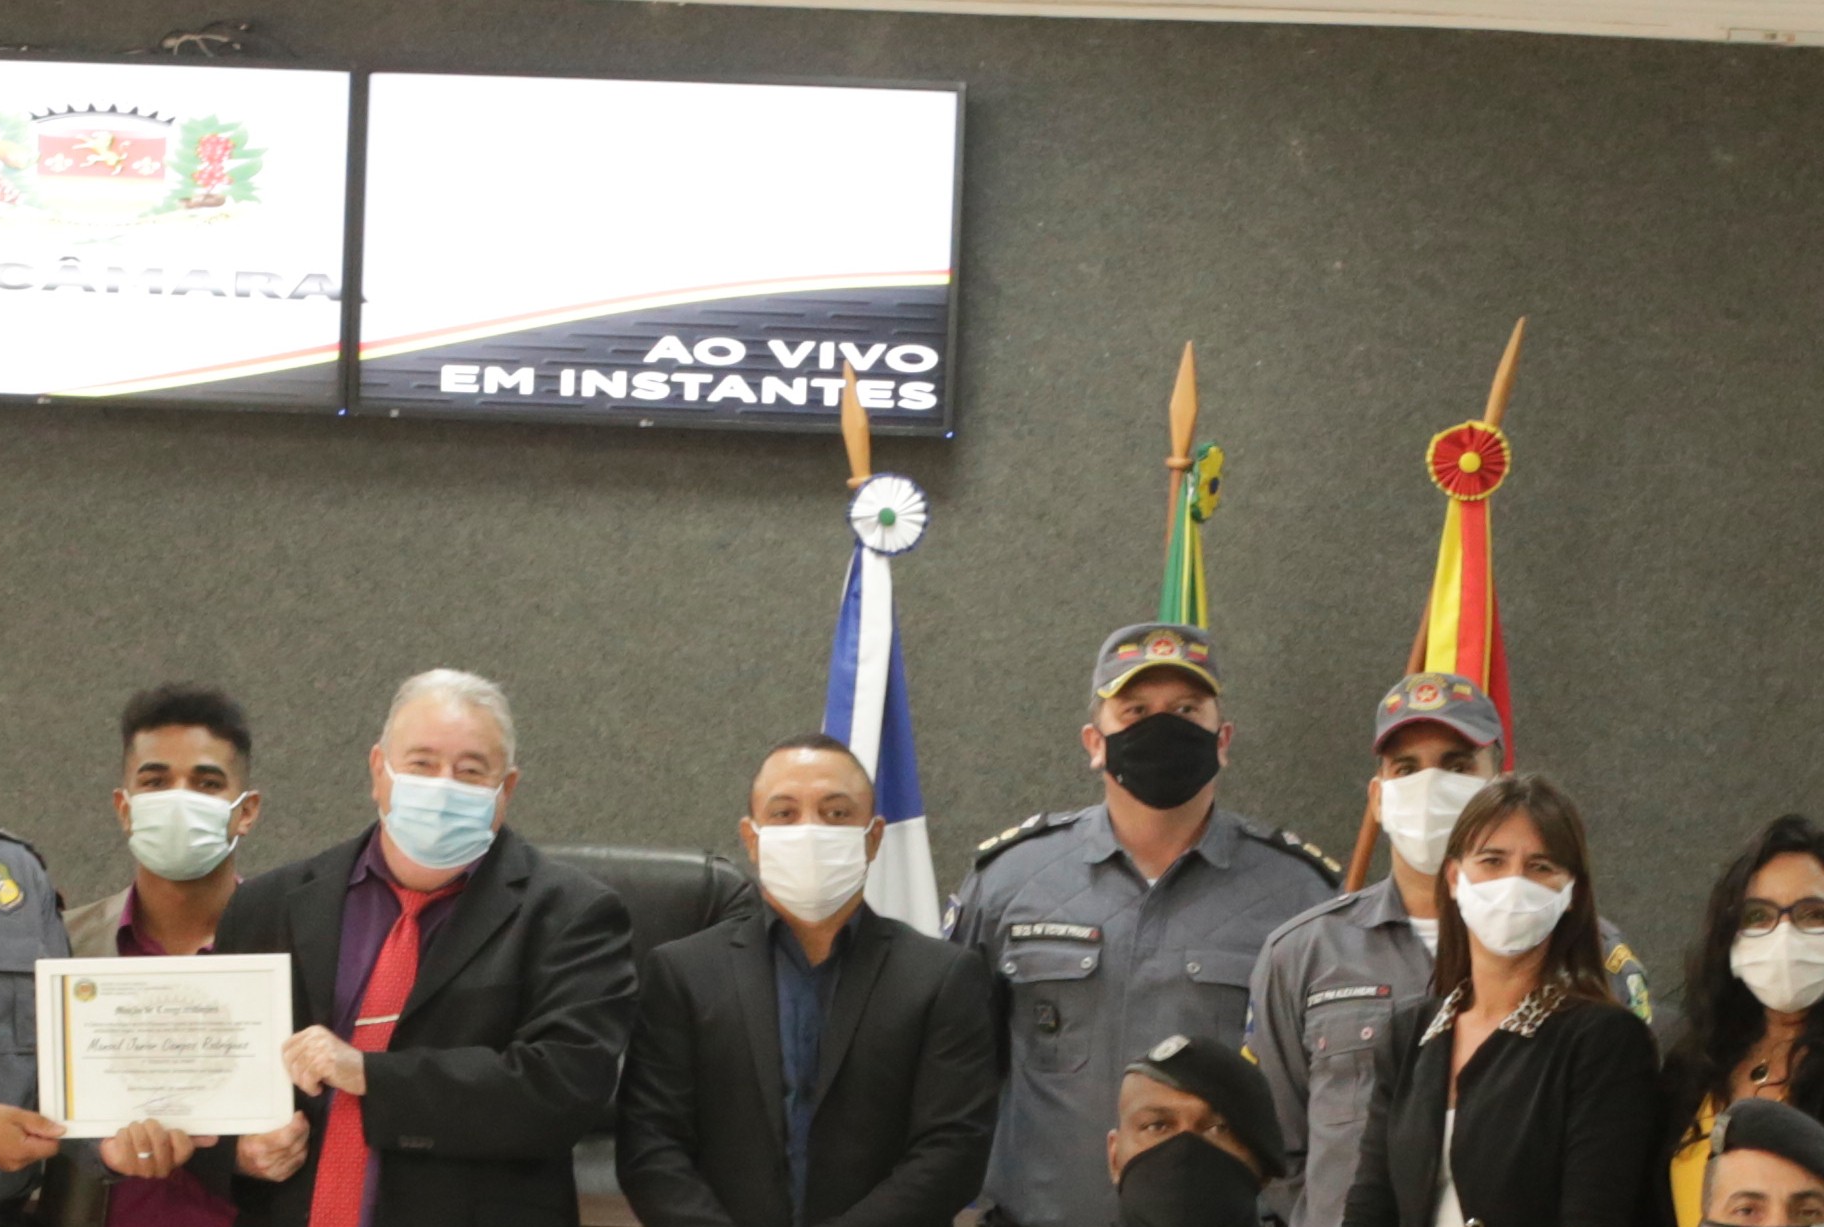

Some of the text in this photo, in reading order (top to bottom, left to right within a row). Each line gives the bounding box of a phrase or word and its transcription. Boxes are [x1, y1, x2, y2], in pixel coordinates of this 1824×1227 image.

[643, 335, 939, 373] AO VIVO
[440, 365, 938, 410] EM INSTANTES
